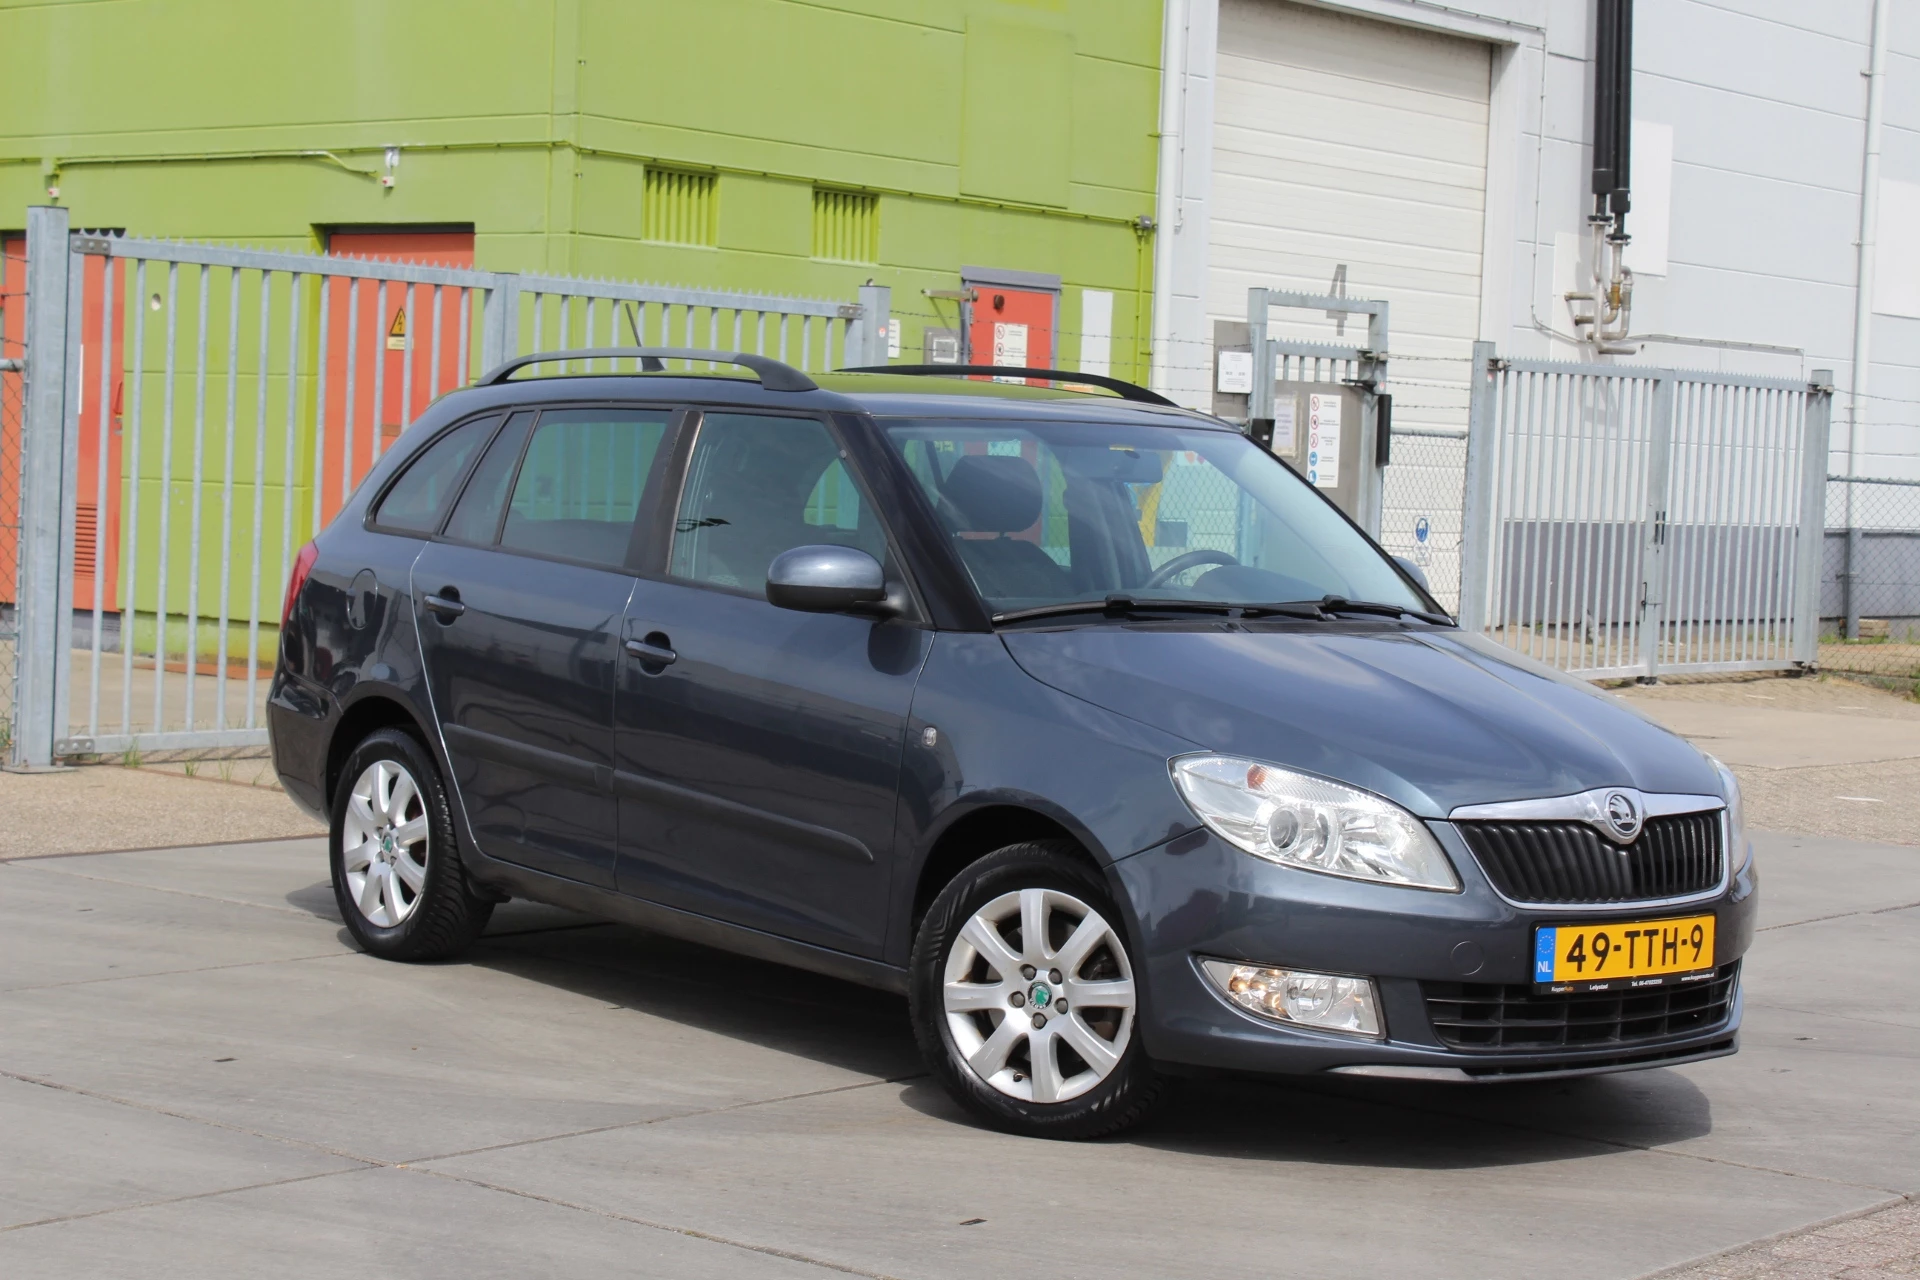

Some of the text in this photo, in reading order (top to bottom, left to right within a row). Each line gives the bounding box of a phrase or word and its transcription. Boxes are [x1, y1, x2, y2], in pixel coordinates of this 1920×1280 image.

[1326, 264, 1347, 336] 4
[1537, 961, 1552, 973] NL
[1566, 924, 1703, 973] 49-TTH-9
